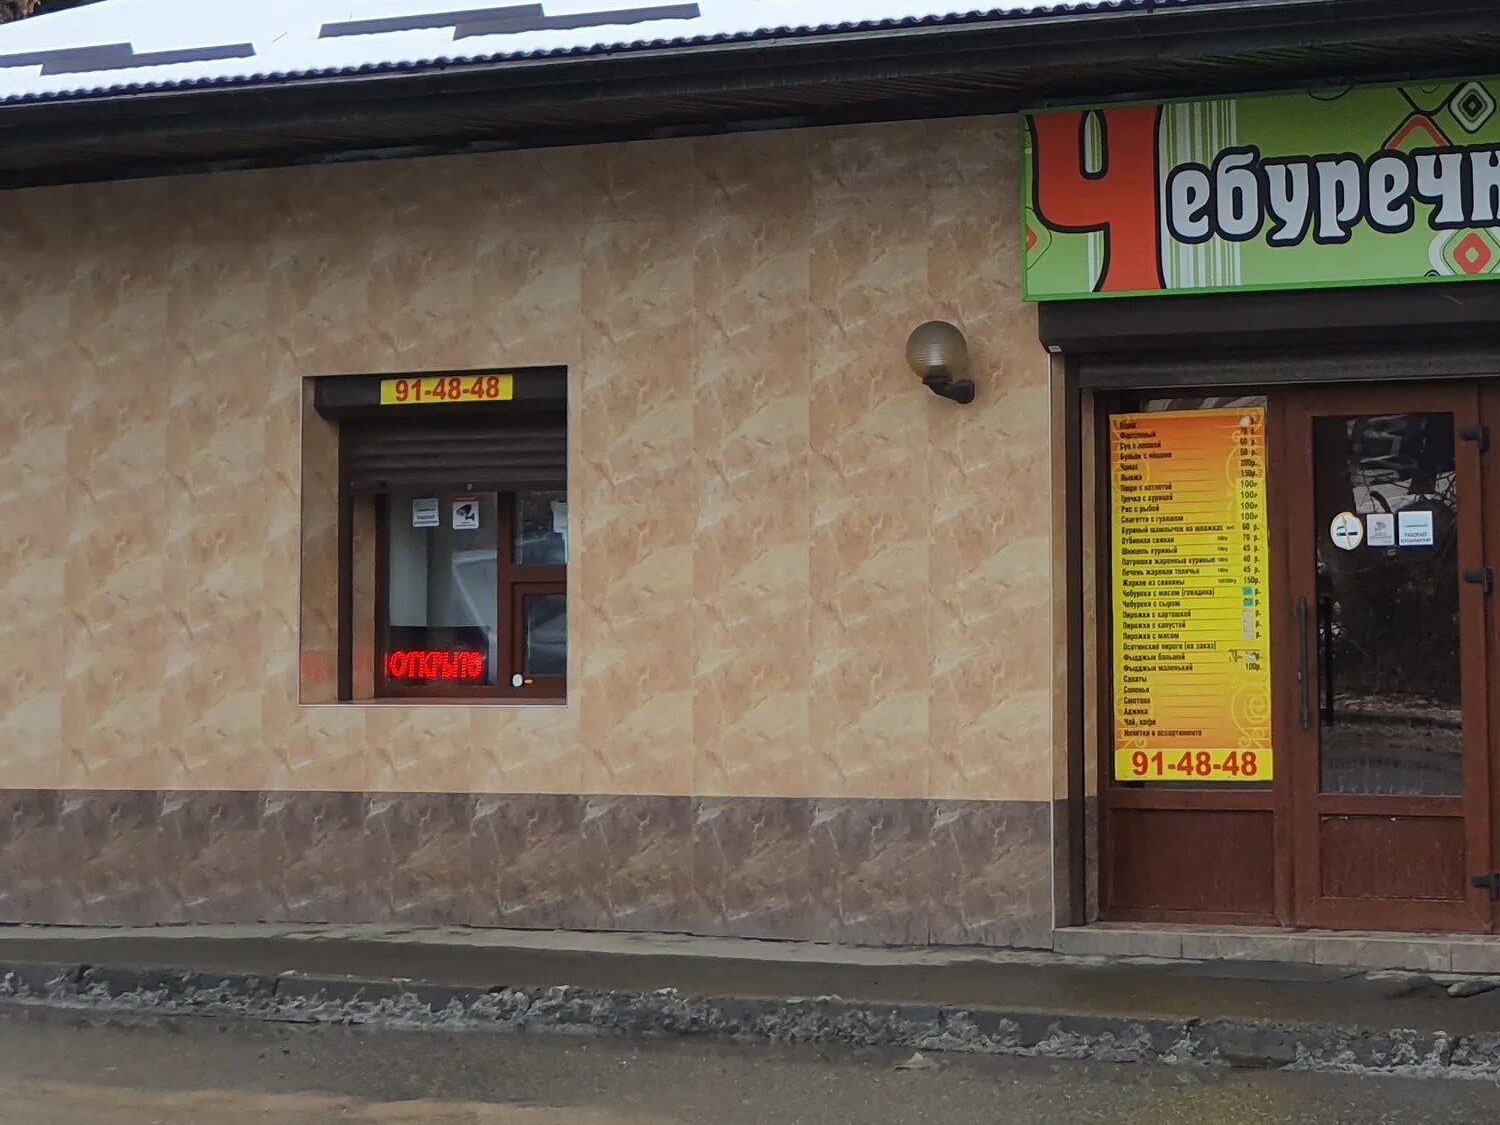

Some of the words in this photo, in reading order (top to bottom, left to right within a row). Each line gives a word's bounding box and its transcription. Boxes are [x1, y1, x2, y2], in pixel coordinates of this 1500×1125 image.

[395, 376, 500, 402] 91-48-48
[1120, 442, 1131, 450] Суп
[1121, 526, 1148, 535] Куриный
[1242, 533, 1250, 541] 70
[1243, 576, 1261, 584] 150р.
[1122, 590, 1151, 598] Чебуреки
[1122, 600, 1151, 608] Чебуреки
[390, 651, 483, 678] ОТКРЫТО
[1245, 663, 1263, 671] 100р.
[1132, 751, 1257, 776] 91-48-48
